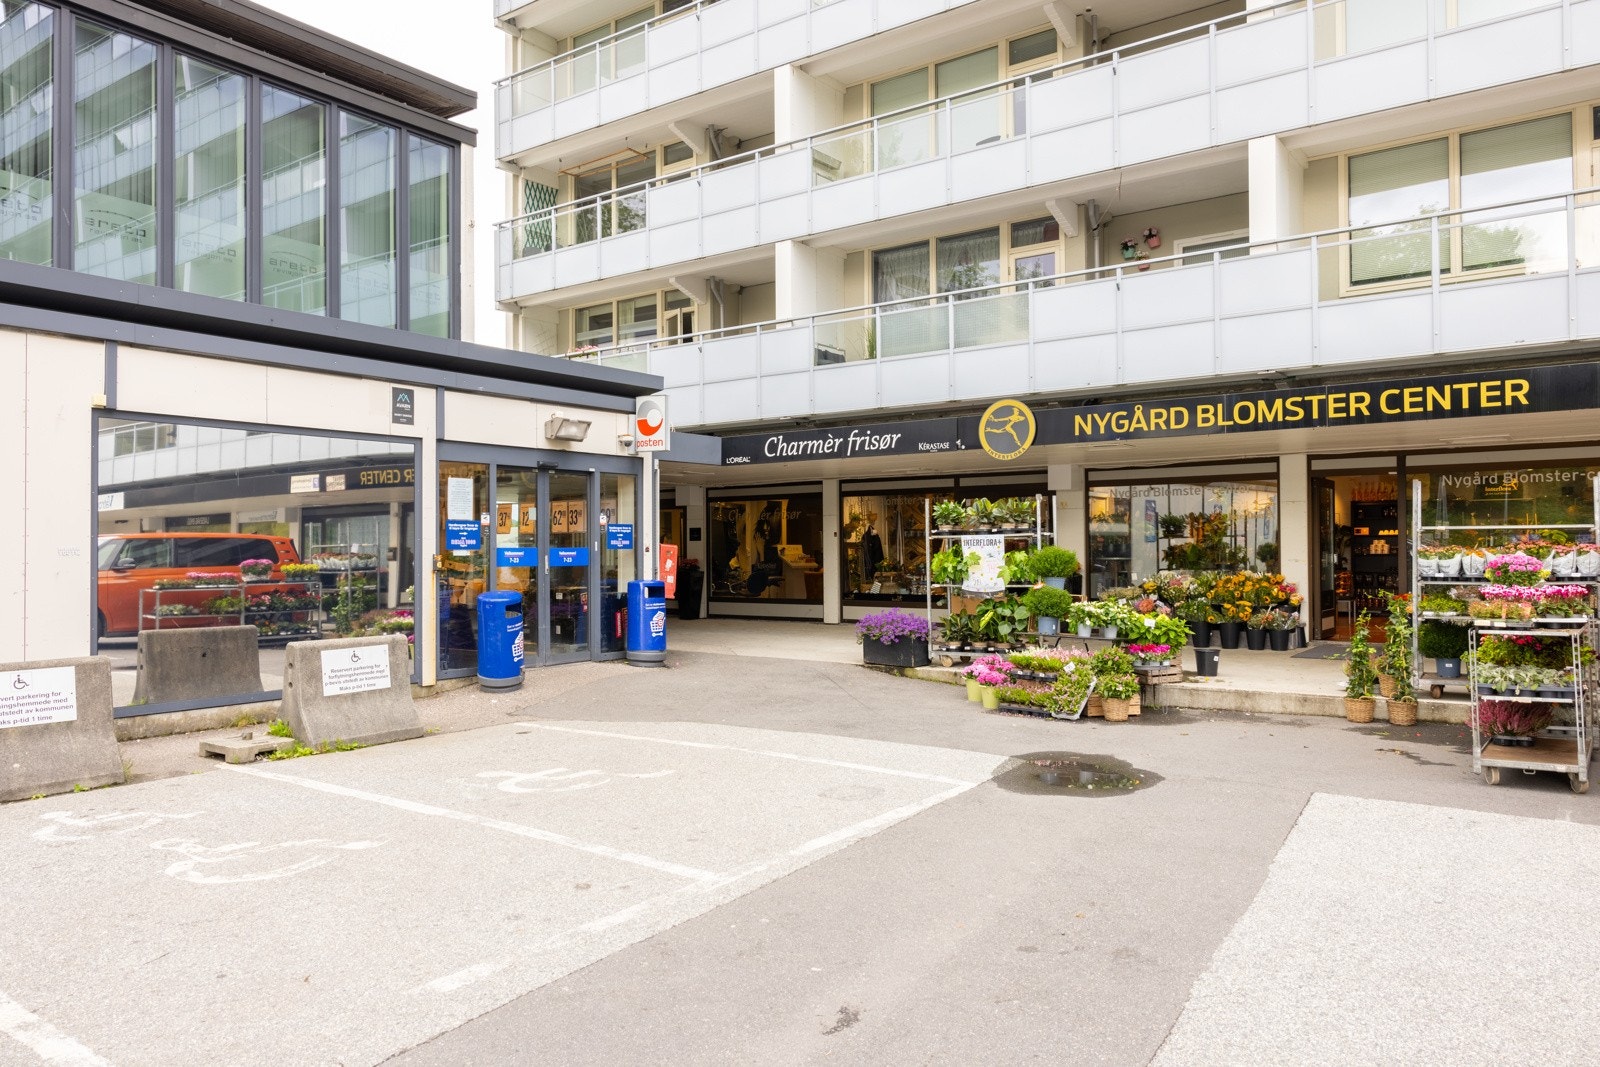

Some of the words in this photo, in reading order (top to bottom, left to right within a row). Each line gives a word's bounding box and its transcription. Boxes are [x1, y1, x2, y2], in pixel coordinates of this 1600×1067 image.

[1074, 404, 1189, 436] NYGÅRD
[1197, 391, 1371, 428] BLOMSTER
[1379, 378, 1530, 415] CENTER
[636, 438, 664, 449] posten
[764, 433, 844, 458] Charmèr
[846, 429, 902, 457] frisør
[987, 447, 1026, 460] INTERFLORA
[1441, 471, 1498, 489] Nygård
[1110, 484, 1150, 500] Nygård
[498, 512, 508, 527] 37
[553, 510, 563, 526] 62
[569, 509, 578, 526] 33
[16, 692, 50, 701] parkering
[35, 704, 74, 712] kommunen
[13, 716, 30, 724] p-tid
